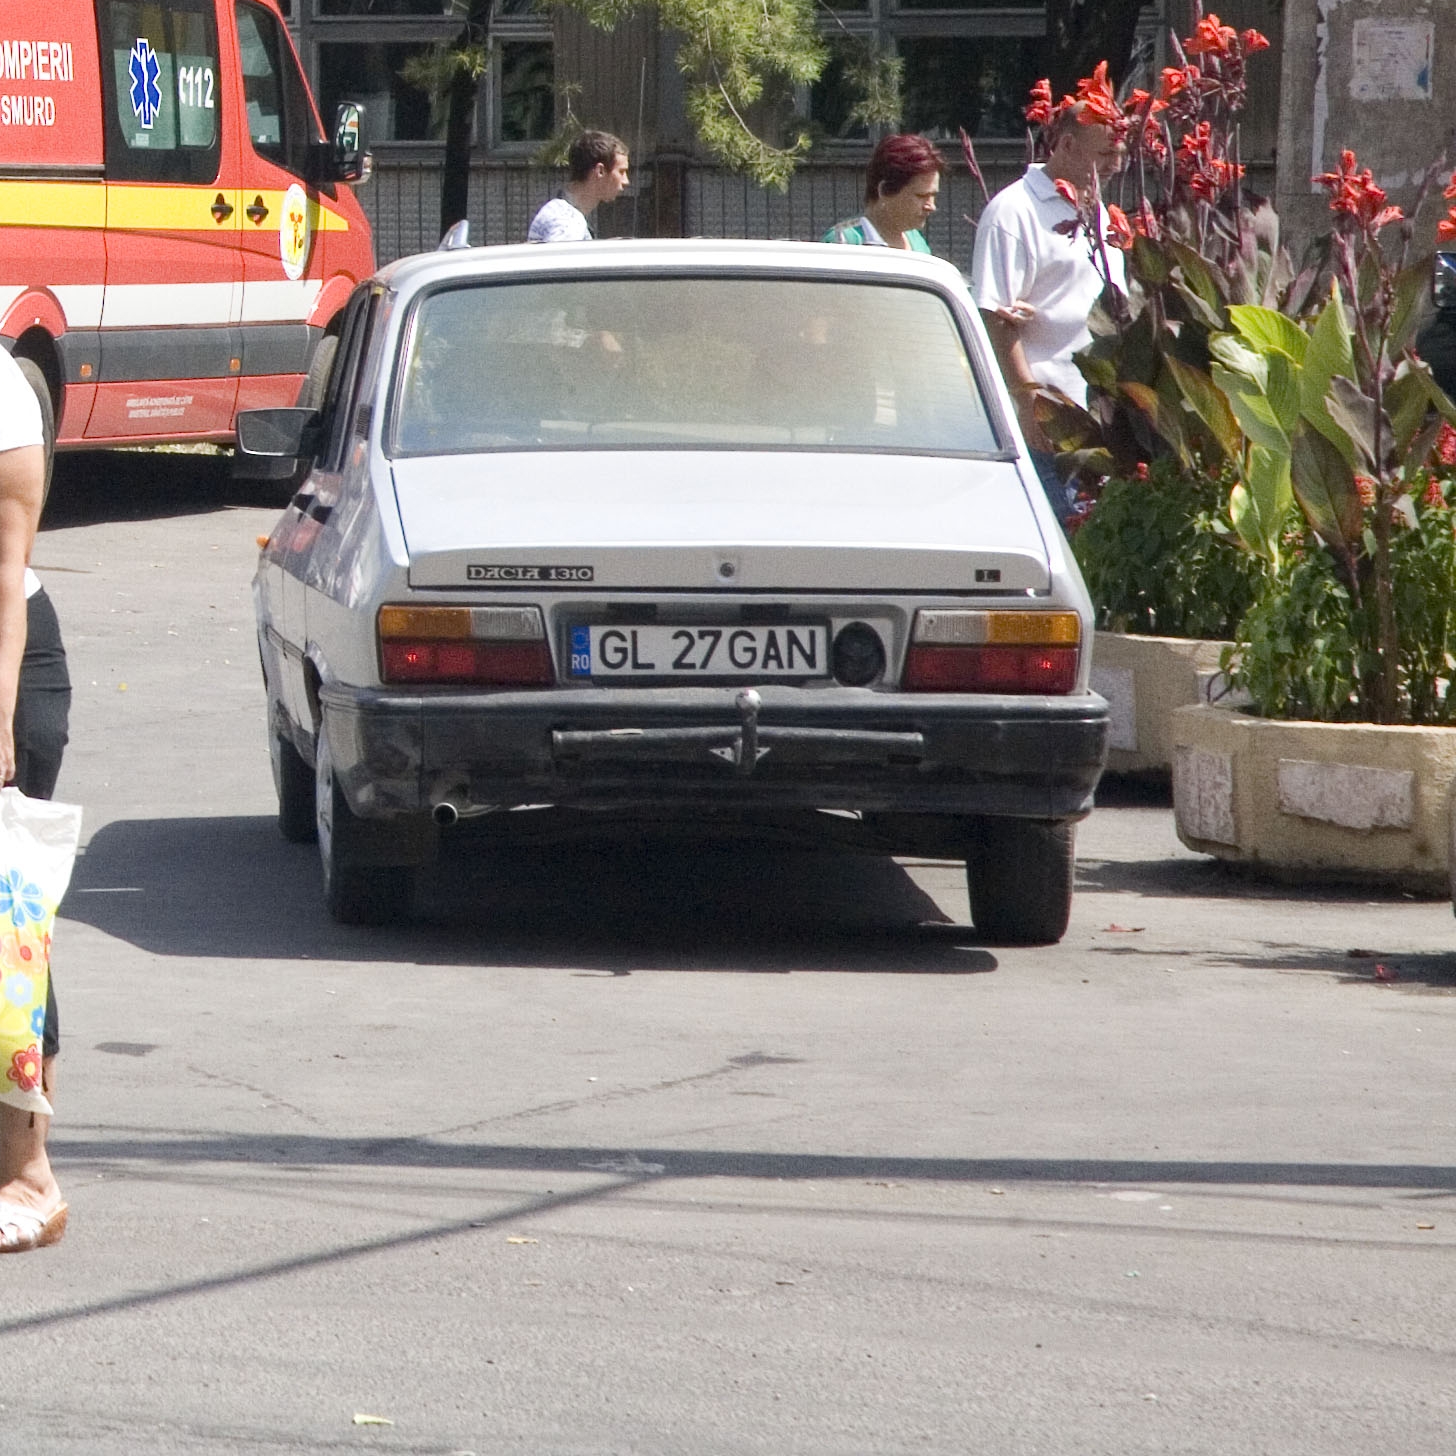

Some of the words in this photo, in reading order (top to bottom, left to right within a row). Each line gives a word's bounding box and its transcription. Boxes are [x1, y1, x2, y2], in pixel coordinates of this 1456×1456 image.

[0, 94, 56, 127] SMURD
[469, 566, 540, 580] DACIA
[548, 568, 592, 580] 1310
[599, 629, 655, 670] GL
[672, 629, 722, 670] 27
[728, 629, 817, 670] GAN
[572, 654, 589, 670] RO
